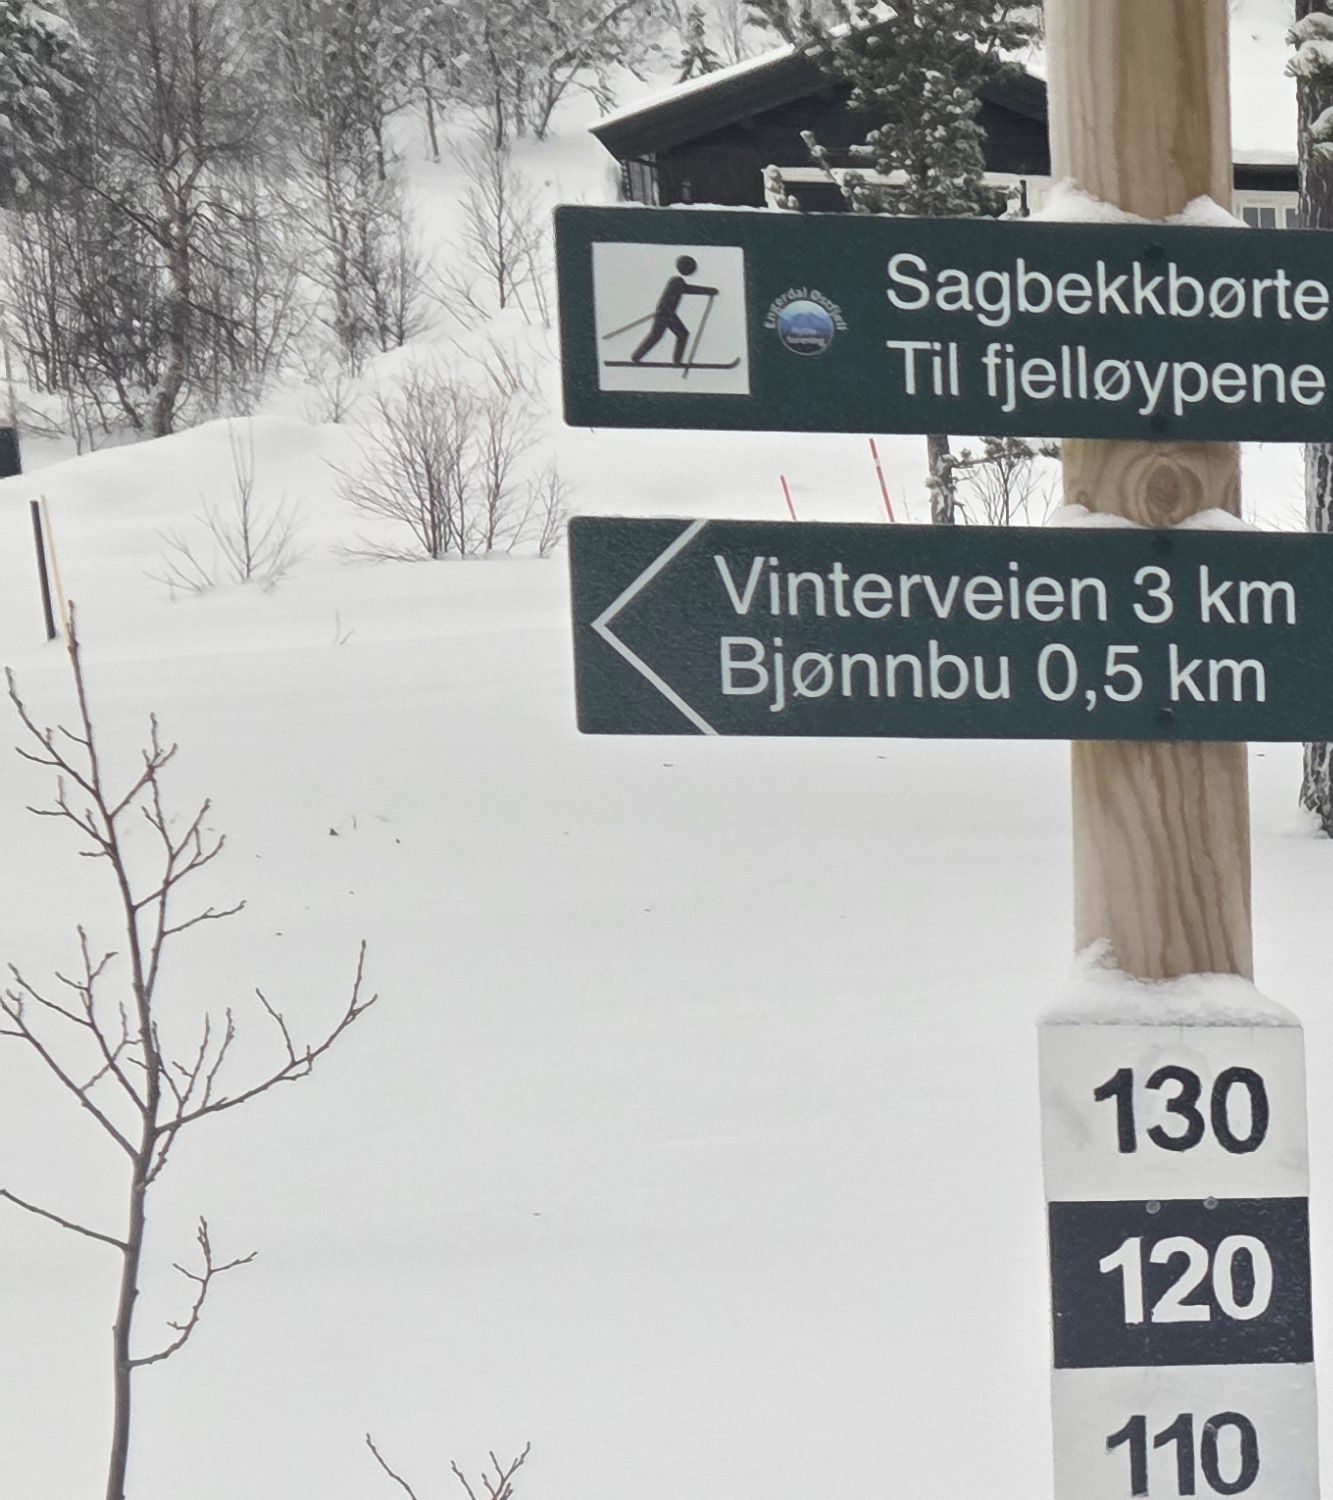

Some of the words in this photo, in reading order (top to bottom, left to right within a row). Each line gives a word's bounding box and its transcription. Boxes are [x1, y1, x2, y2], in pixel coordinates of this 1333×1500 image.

[885, 252, 1330, 328] Sagbekkbørte
[885, 339, 960, 398] Til
[980, 342, 1326, 417] fjelløypene
[713, 554, 1108, 622] Vinterveien
[1132, 565, 1174, 624] 3
[1199, 564, 1297, 625] km
[719, 635, 1011, 713] Bjønnbu
[1036, 643, 1143, 712] 0,5
[1168, 643, 1267, 703] km
[1093, 1064, 1270, 1155] 130
[1098, 1234, 1274, 1325] 120
[1105, 1411, 1260, 1499] 110
